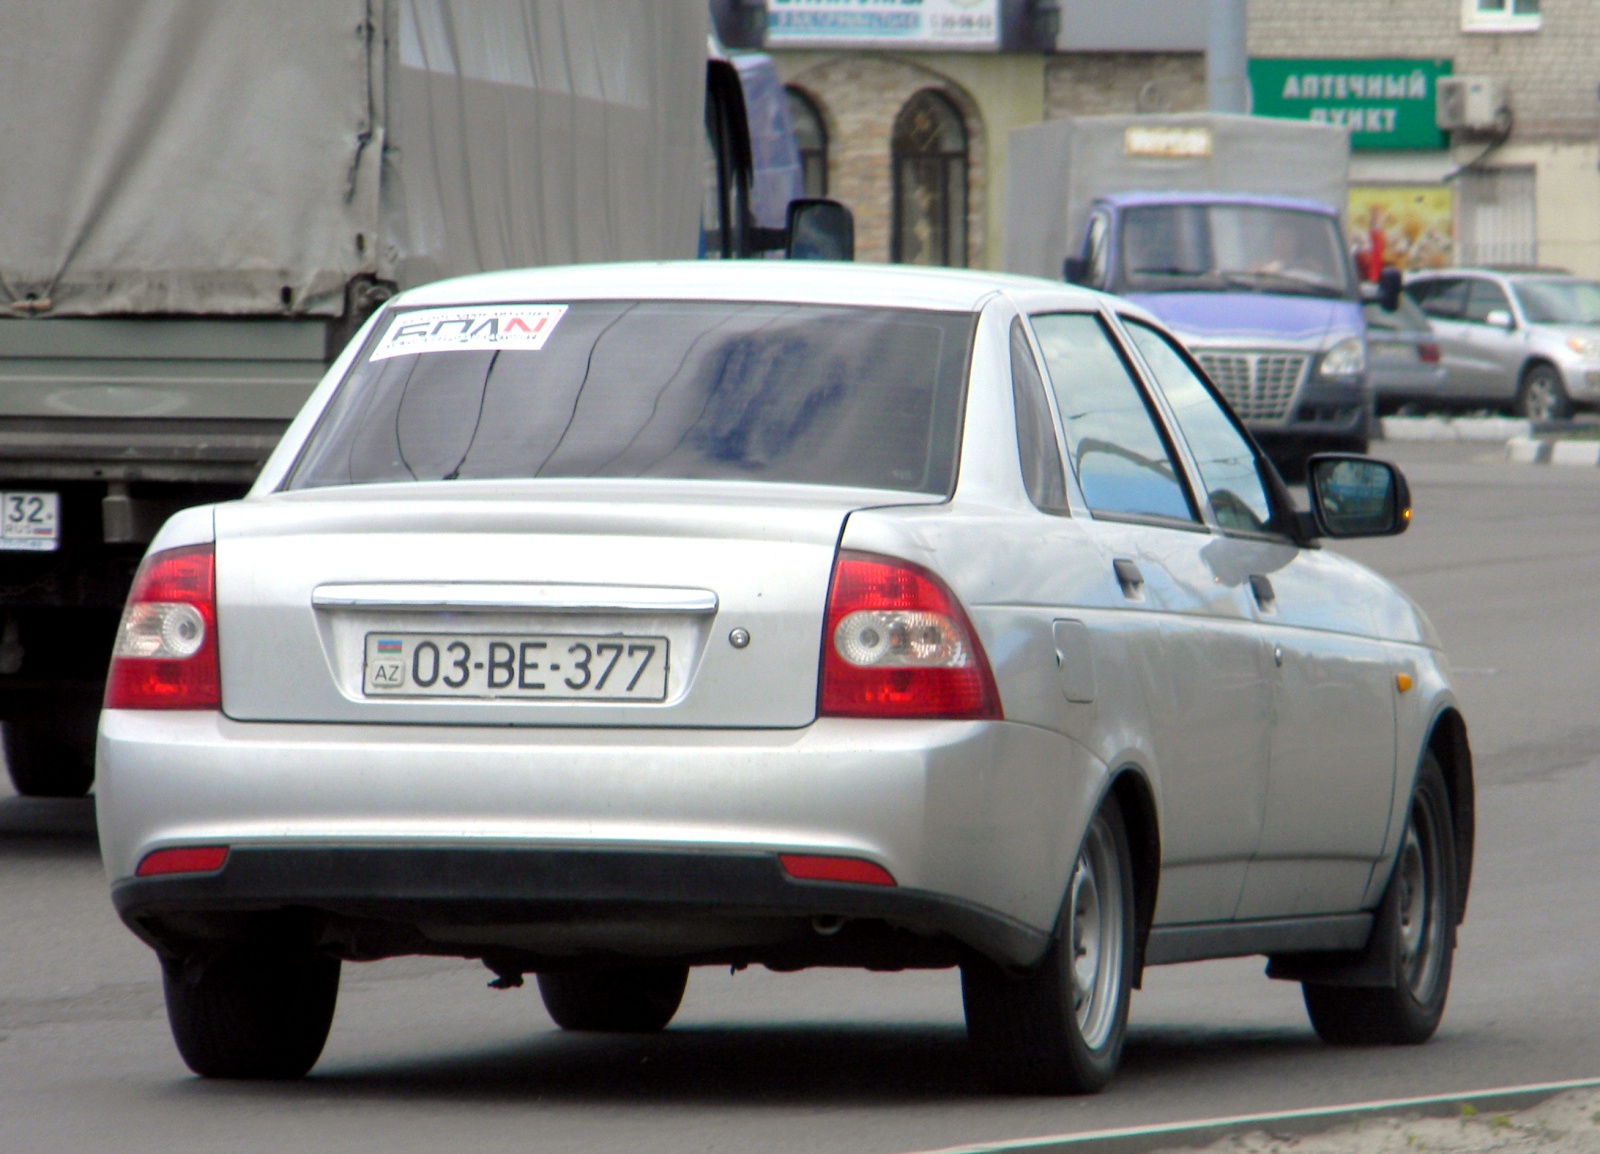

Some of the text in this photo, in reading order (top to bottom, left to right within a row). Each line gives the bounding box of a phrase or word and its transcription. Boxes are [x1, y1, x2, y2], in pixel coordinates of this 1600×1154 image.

[1282, 69, 1427, 98] АПТЕЧНЫЙ
[8, 496, 44, 523] 32
[374, 664, 400, 681] AZ
[411, 640, 656, 692] 03-BE-377
